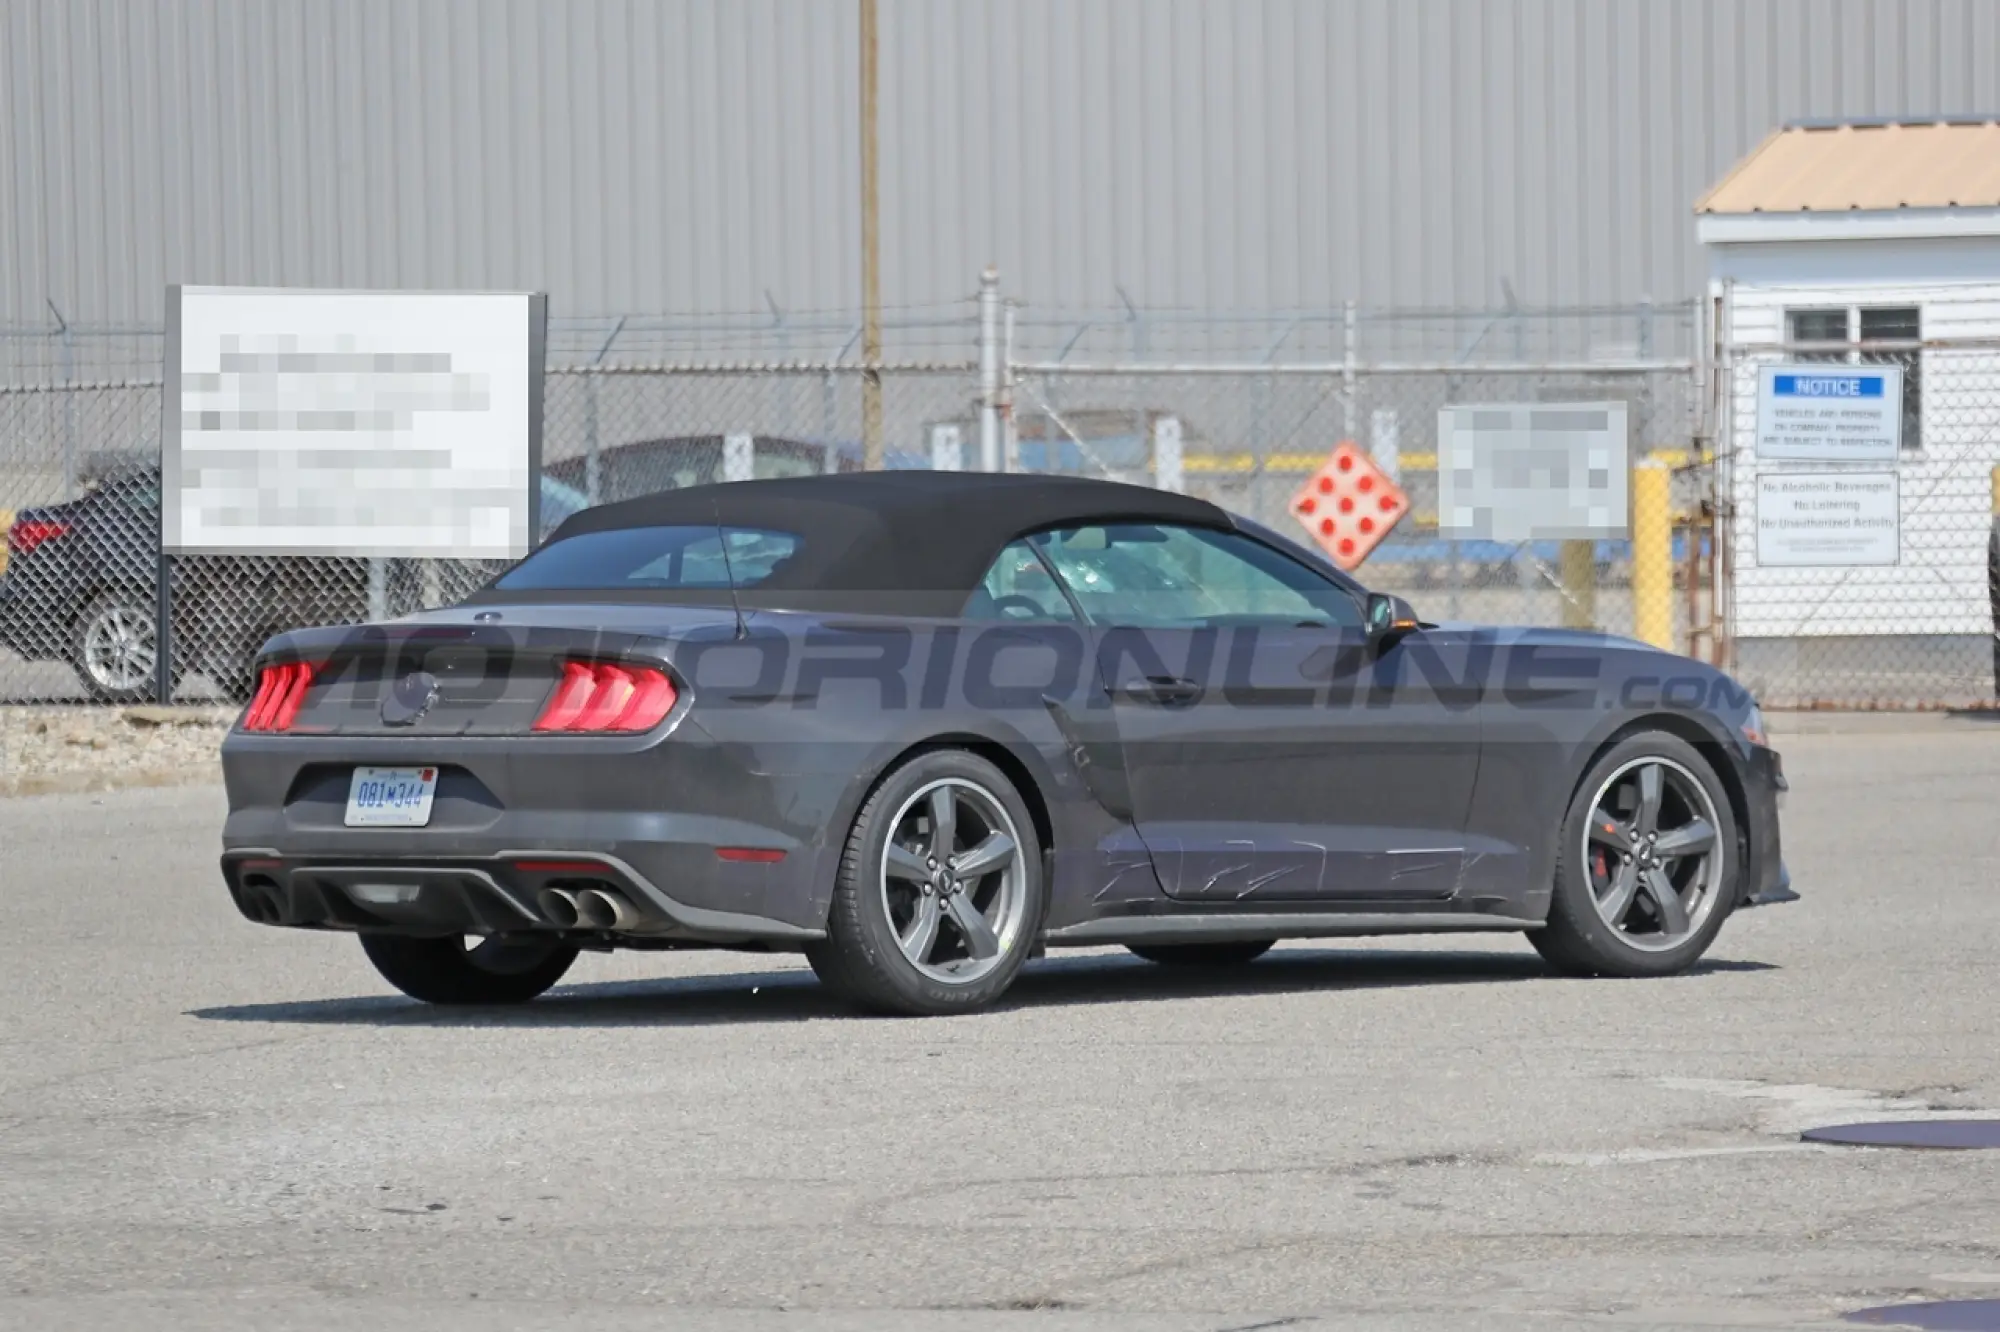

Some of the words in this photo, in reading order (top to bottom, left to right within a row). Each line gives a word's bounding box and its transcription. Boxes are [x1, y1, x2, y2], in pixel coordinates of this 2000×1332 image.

[1794, 379, 1861, 396] NOTICE
[1763, 483, 1777, 493] No
[1782, 482, 1831, 493] Alcoholic
[1835, 482, 1891, 495] Beverages
[1794, 500, 1808, 511] No
[1812, 500, 1861, 513] Loitering
[1761, 518, 1775, 529] No
[1780, 518, 1850, 530] Unauthorized
[1854, 518, 1894, 531] Activity
